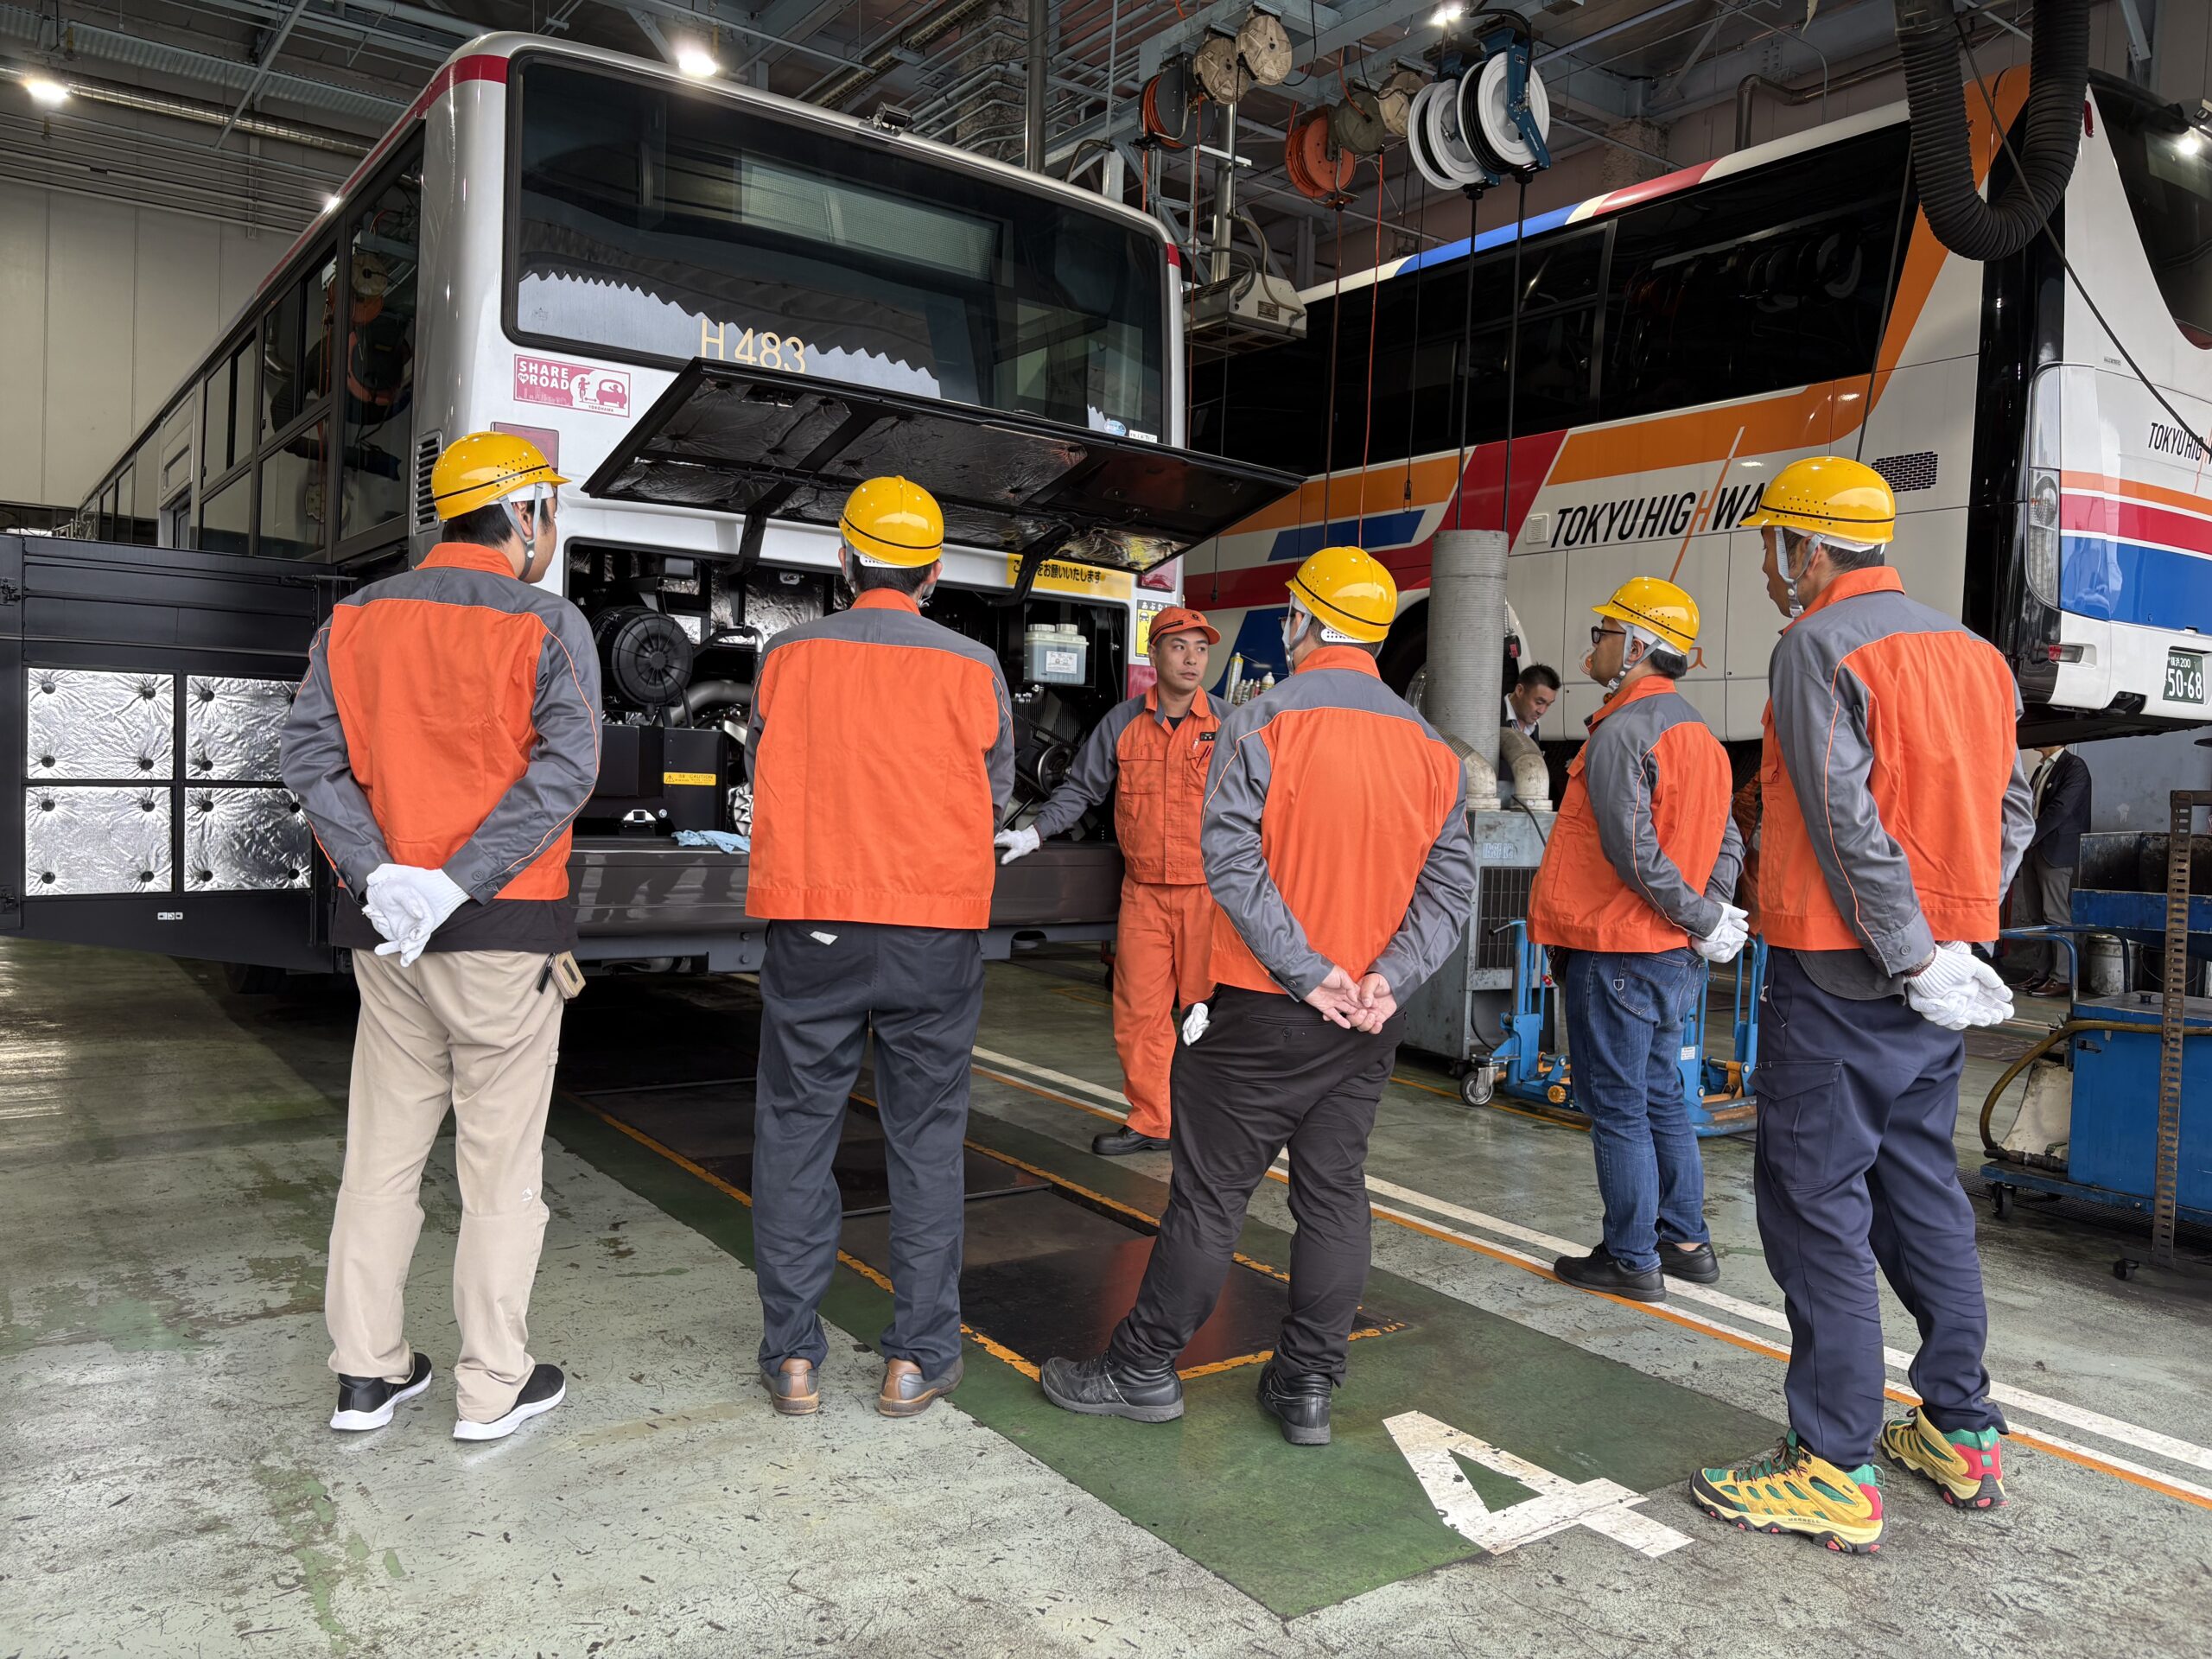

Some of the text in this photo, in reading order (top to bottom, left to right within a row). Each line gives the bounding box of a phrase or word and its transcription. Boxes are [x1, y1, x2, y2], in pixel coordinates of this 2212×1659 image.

[701, 318, 806, 374] H 483
[519, 360, 569, 379] SHARE
[529, 374, 569, 390] ROAD
[588, 404, 614, 413] YOKOHAMA
[1550, 482, 1766, 549] TOKYUHIGHWA
[1382, 1410, 1695, 1558] 4
